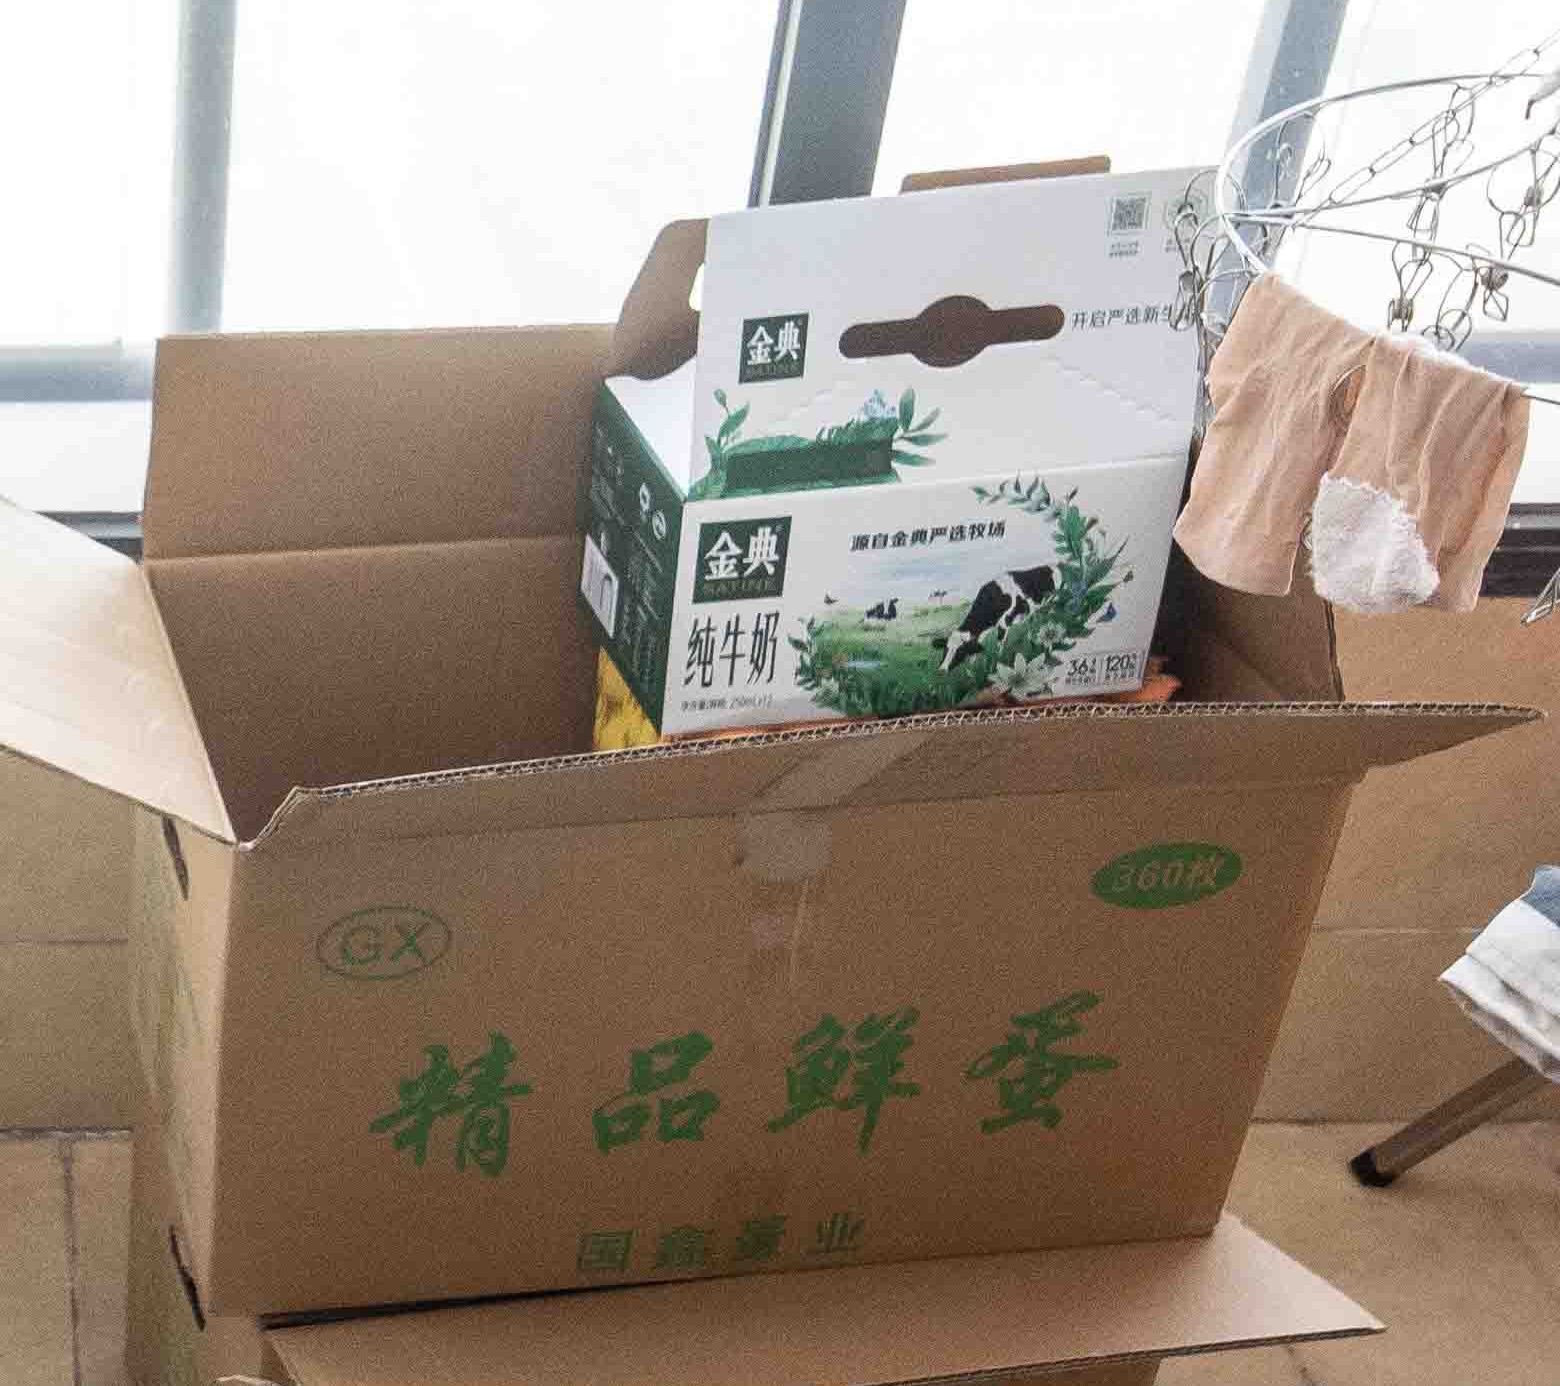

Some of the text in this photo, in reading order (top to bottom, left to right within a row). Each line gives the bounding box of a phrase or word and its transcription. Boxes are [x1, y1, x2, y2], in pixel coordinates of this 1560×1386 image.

[746, 320, 801, 365] 金典
[704, 527, 780, 581] 金典
[850, 518, 1006, 551] 源自金典严选牧场
[684, 611, 780, 688] 纯牛奶
[342, 921, 427, 966] GX
[369, 990, 1121, 1177] 精品鲜蛋
